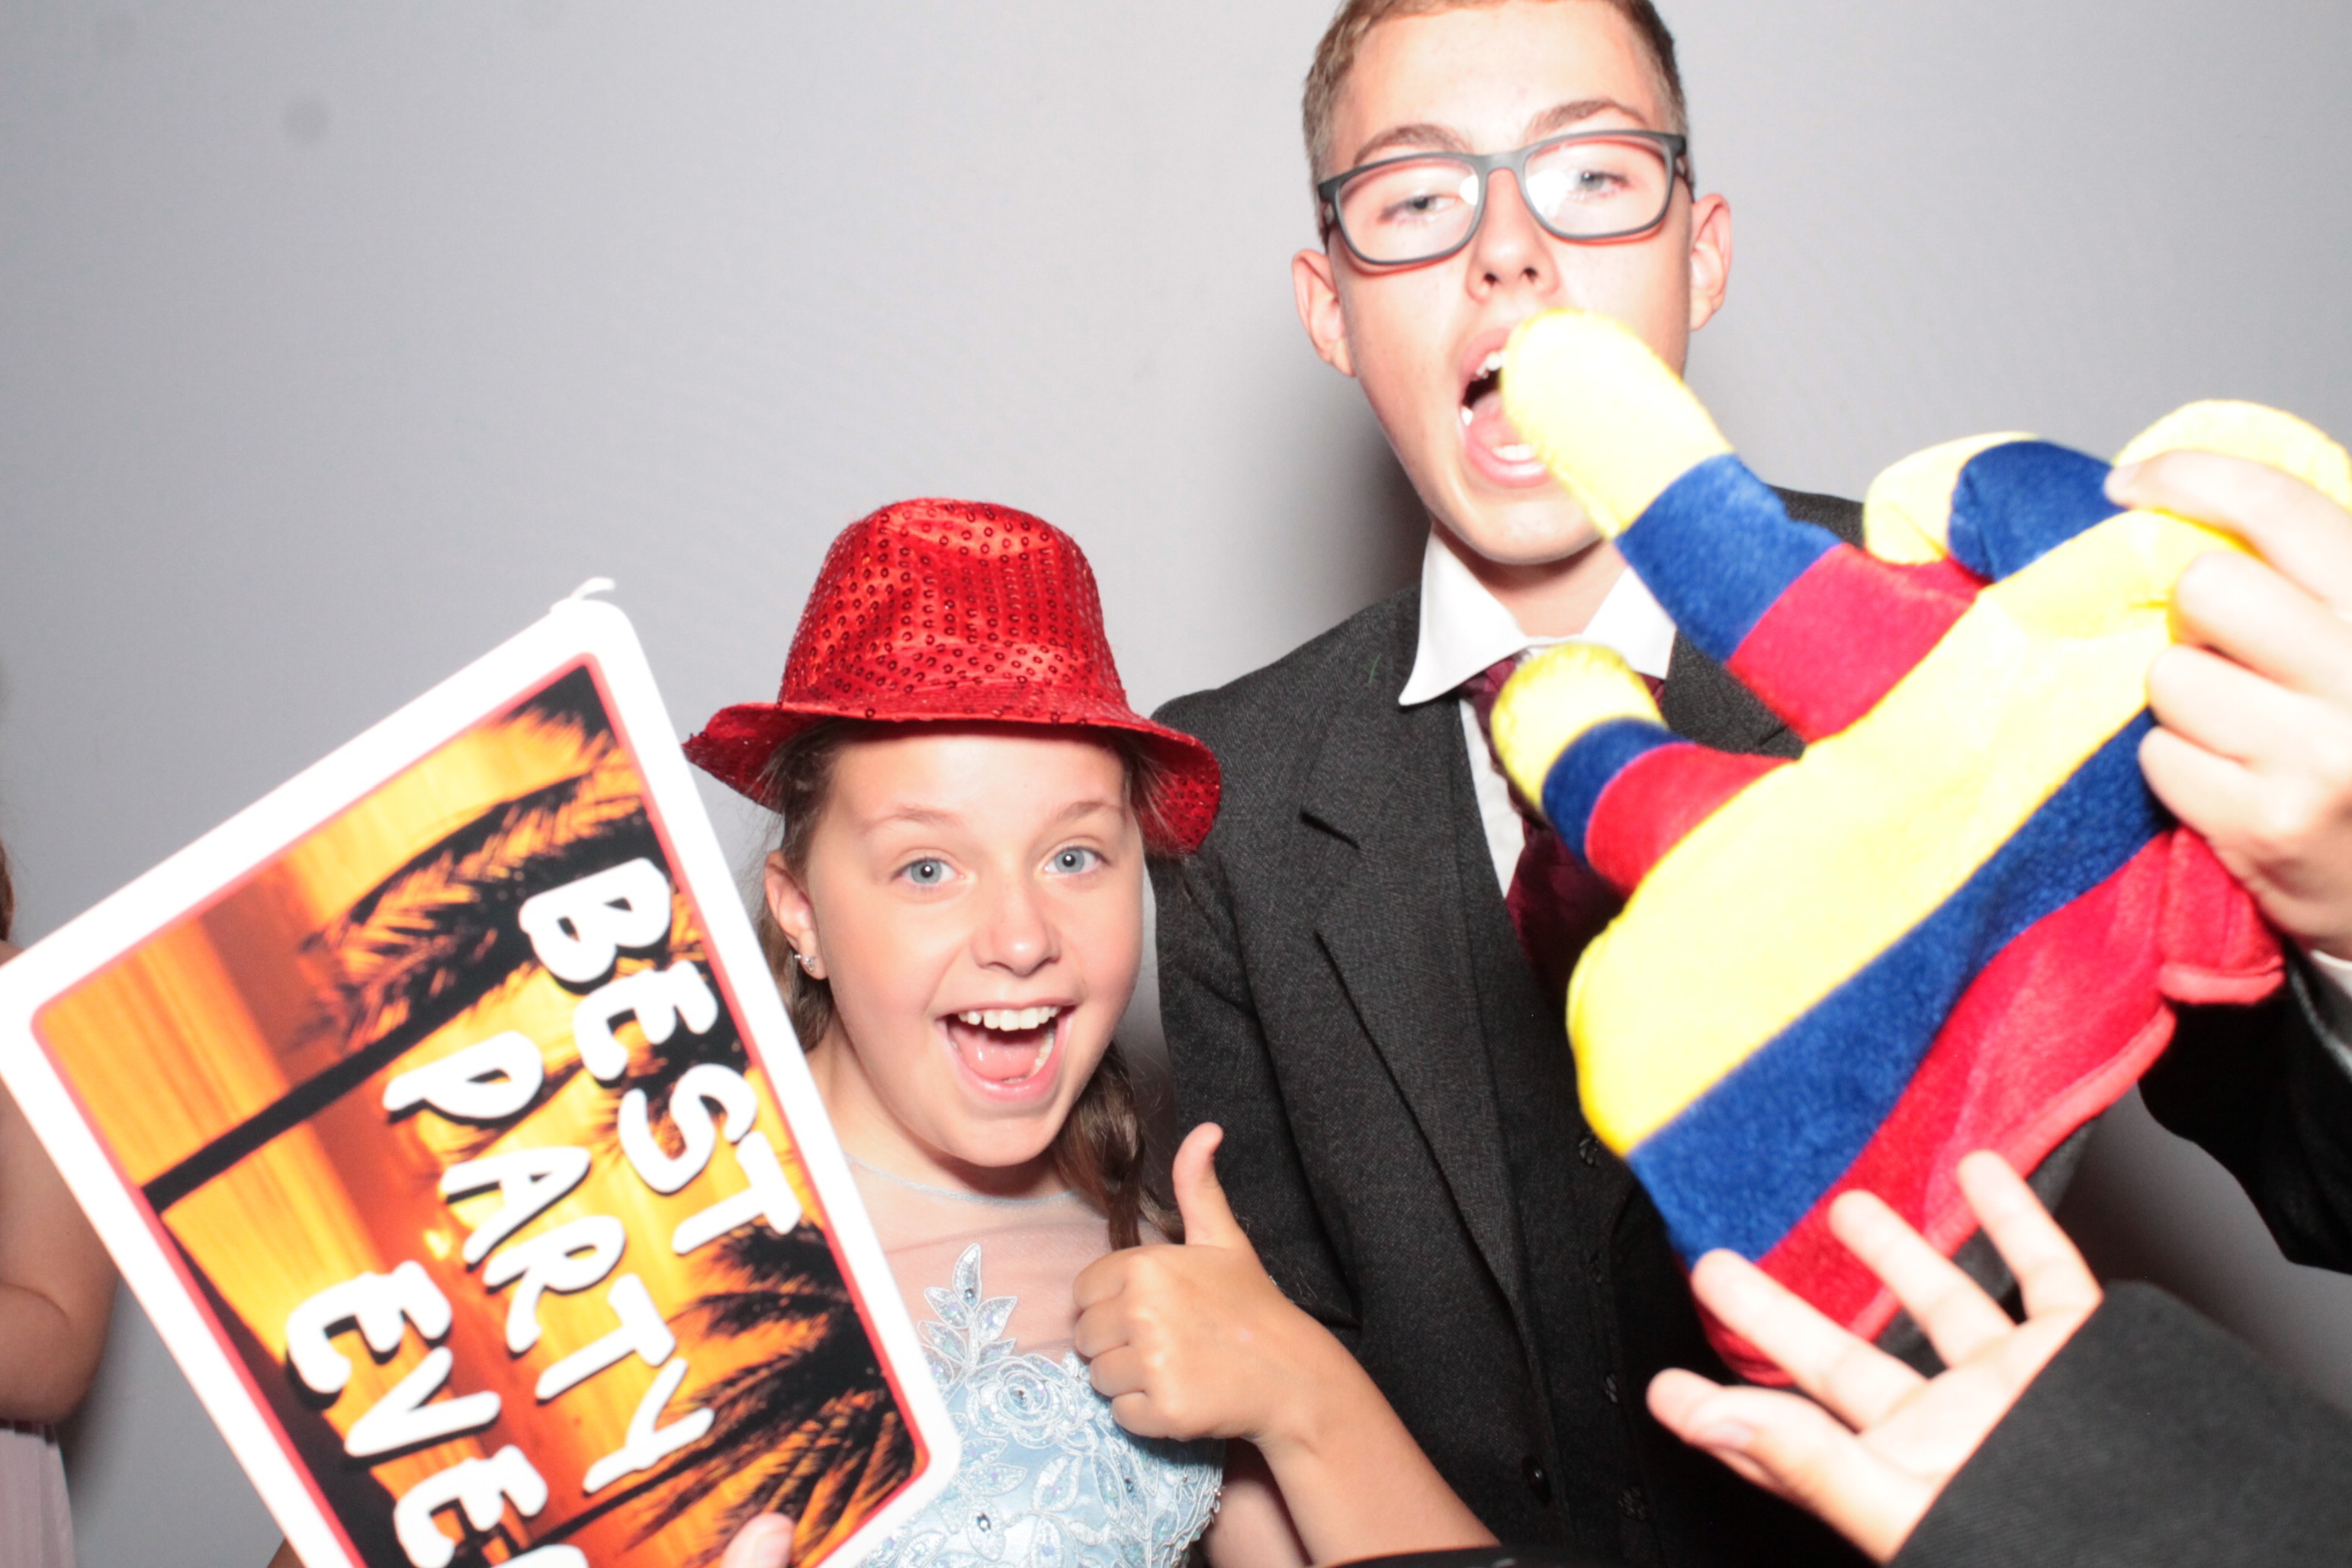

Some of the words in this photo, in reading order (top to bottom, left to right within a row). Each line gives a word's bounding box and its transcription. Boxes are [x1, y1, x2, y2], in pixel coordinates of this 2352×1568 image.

[519, 858, 802, 1253] BEST
[288, 1261, 590, 1568] EVE
[383, 1032, 715, 1492] PARTY
